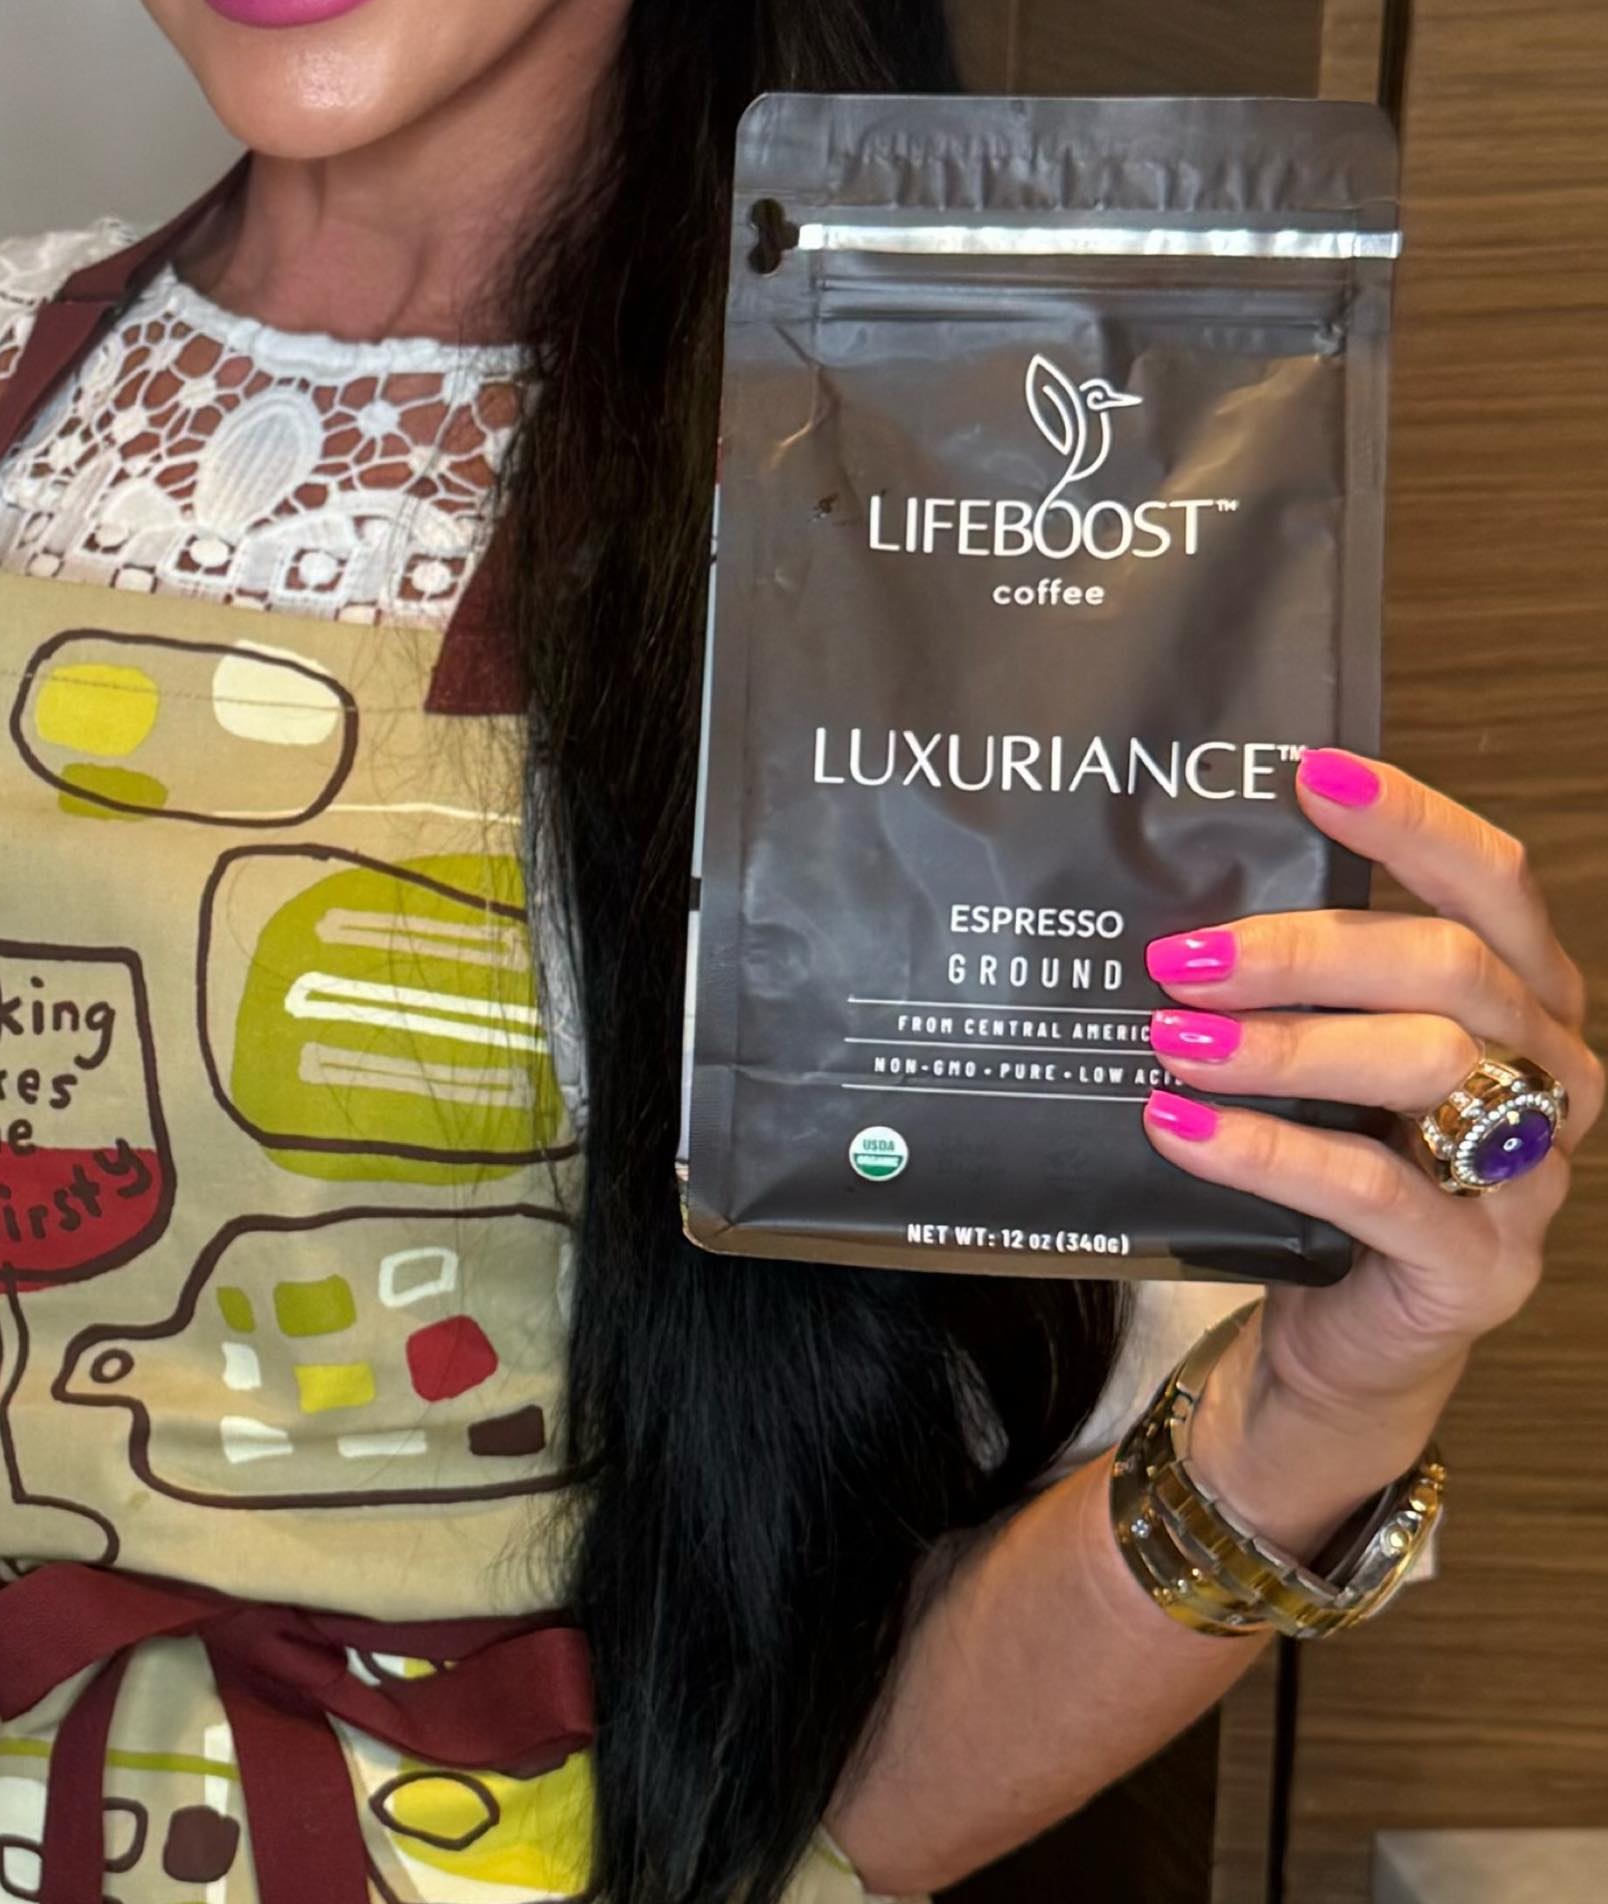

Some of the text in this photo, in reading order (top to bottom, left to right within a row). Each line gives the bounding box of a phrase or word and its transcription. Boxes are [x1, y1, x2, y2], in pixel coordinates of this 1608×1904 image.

[992, 578, 1105, 606] coffee
[949, 903, 1125, 939] ESPRESSO
[947, 953, 1123, 991] GROUND
[897, 1014, 1151, 1043] FROM CENTRAL AMERIC
[873, 1056, 978, 1078] NON-GMO
[998, 1061, 1057, 1081] PURE
[1078, 1065, 1124, 1085] LOW
[862, 1138, 895, 1152] USDA
[906, 1223, 949, 1245] NET
[954, 1225, 996, 1248] WT:
[1001, 1228, 1024, 1250] 12
